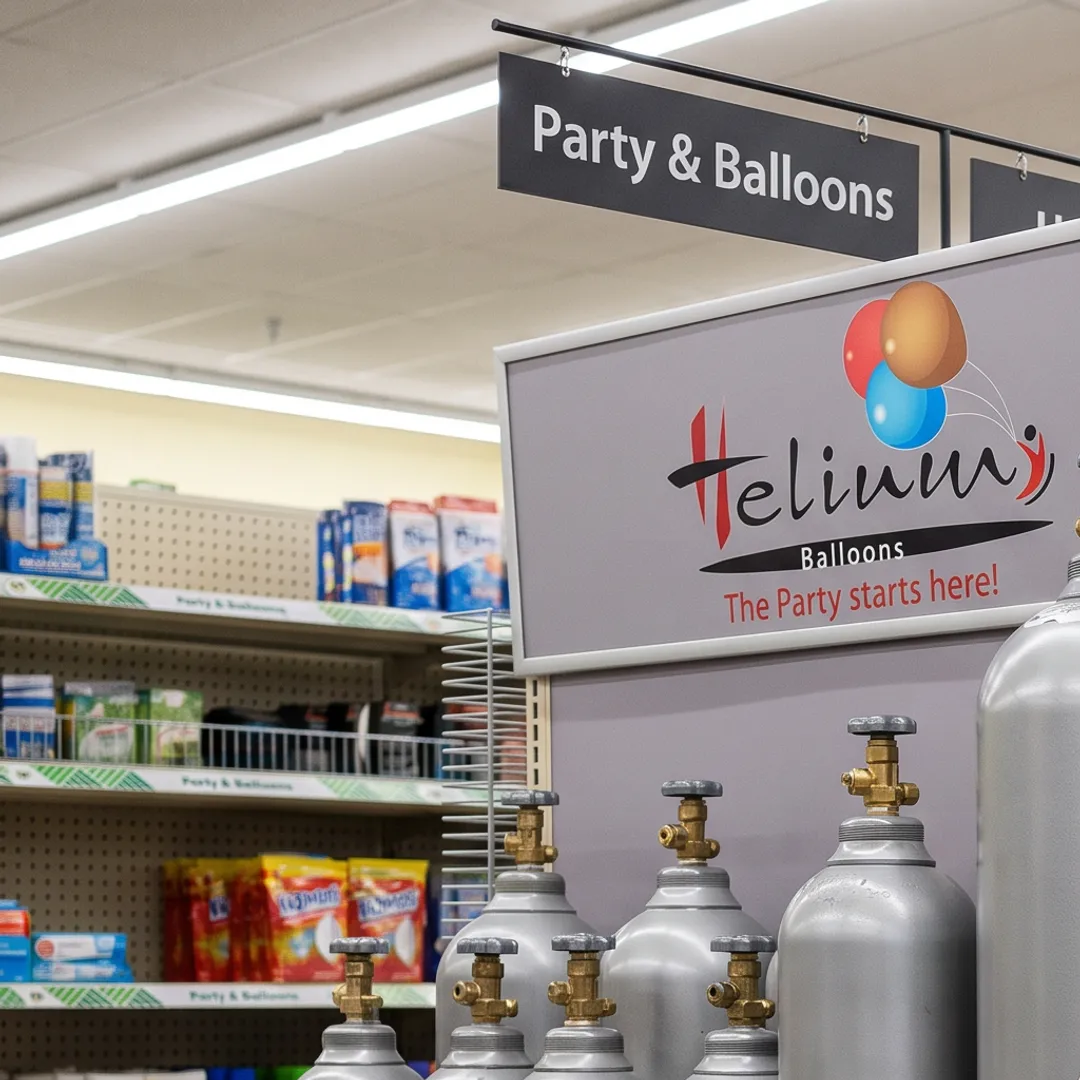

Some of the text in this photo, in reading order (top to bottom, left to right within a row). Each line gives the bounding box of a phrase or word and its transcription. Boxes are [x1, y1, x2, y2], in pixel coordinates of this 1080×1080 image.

[533, 104, 896, 223] Party & Balloons
[800, 538, 906, 571] Balloons
[724, 564, 1000, 624] The Party starts here!
